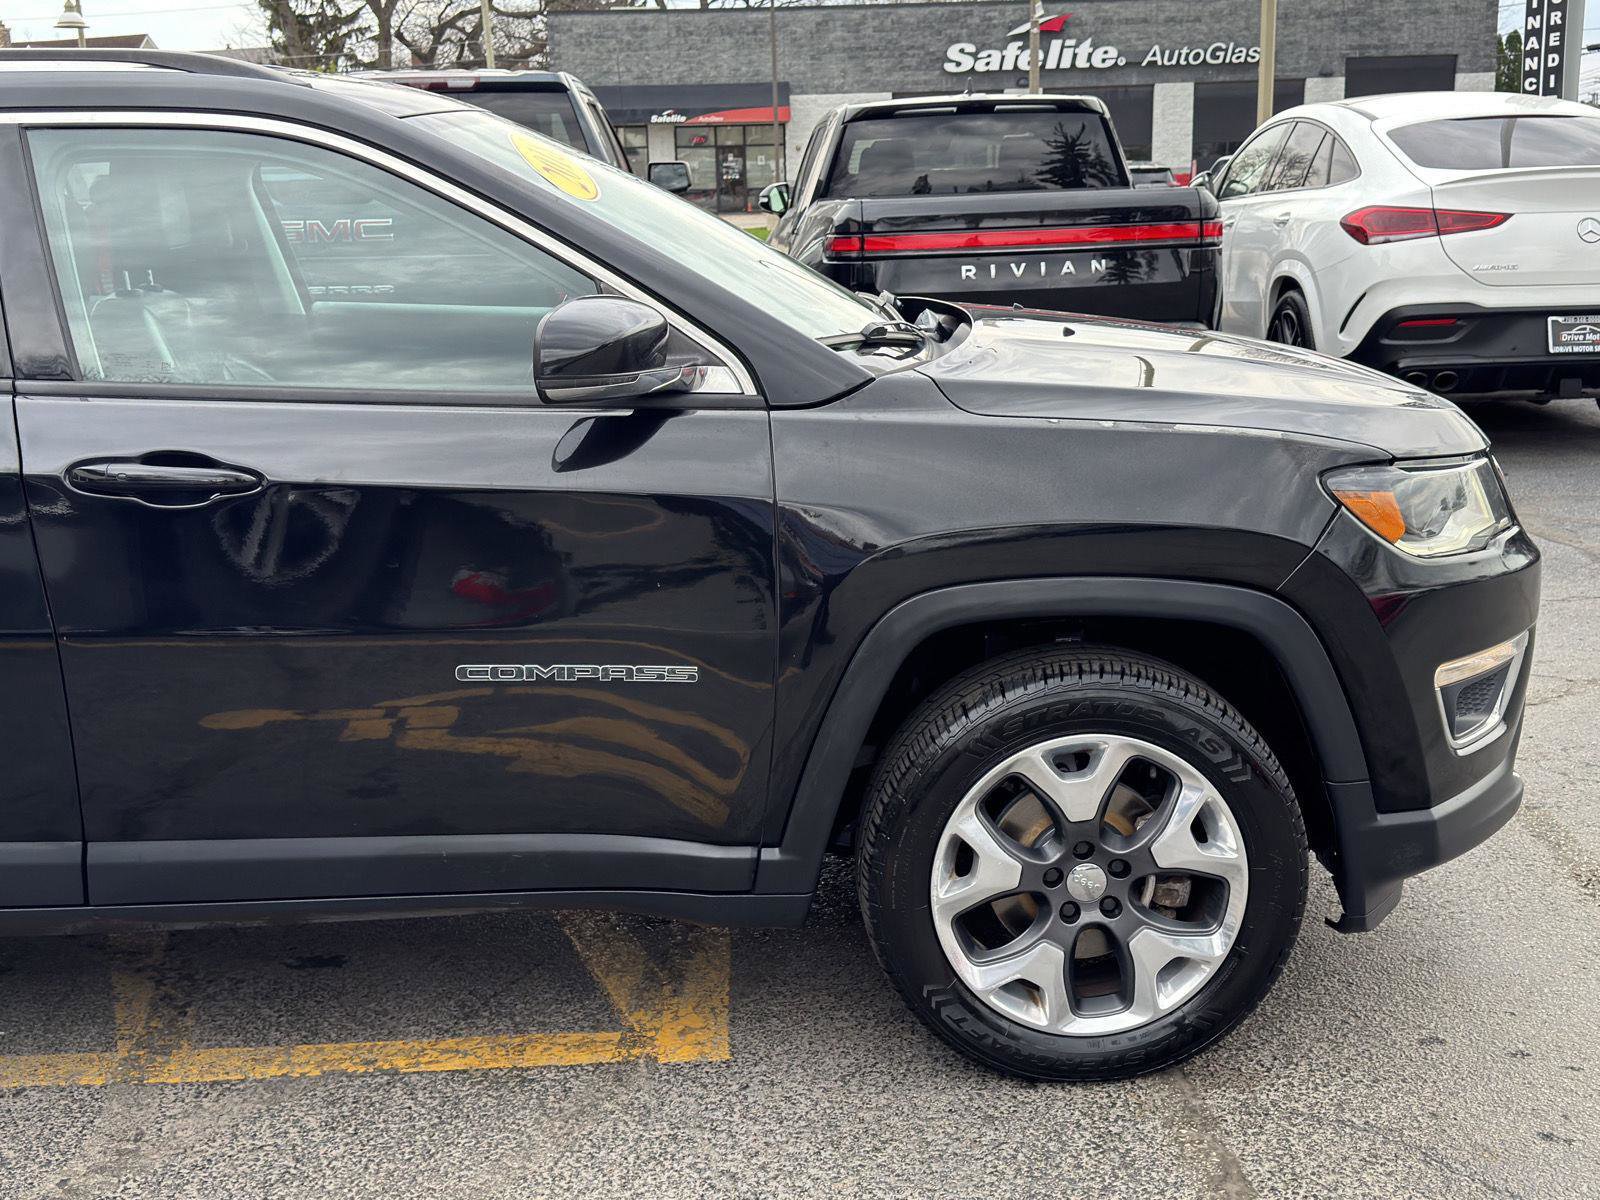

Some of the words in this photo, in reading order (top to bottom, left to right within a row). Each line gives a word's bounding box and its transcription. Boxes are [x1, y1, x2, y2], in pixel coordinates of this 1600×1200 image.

[960, 259, 1106, 280] RIVIAN
[1561, 333, 1584, 342] Drive
[455, 664, 698, 683] COMPASS
